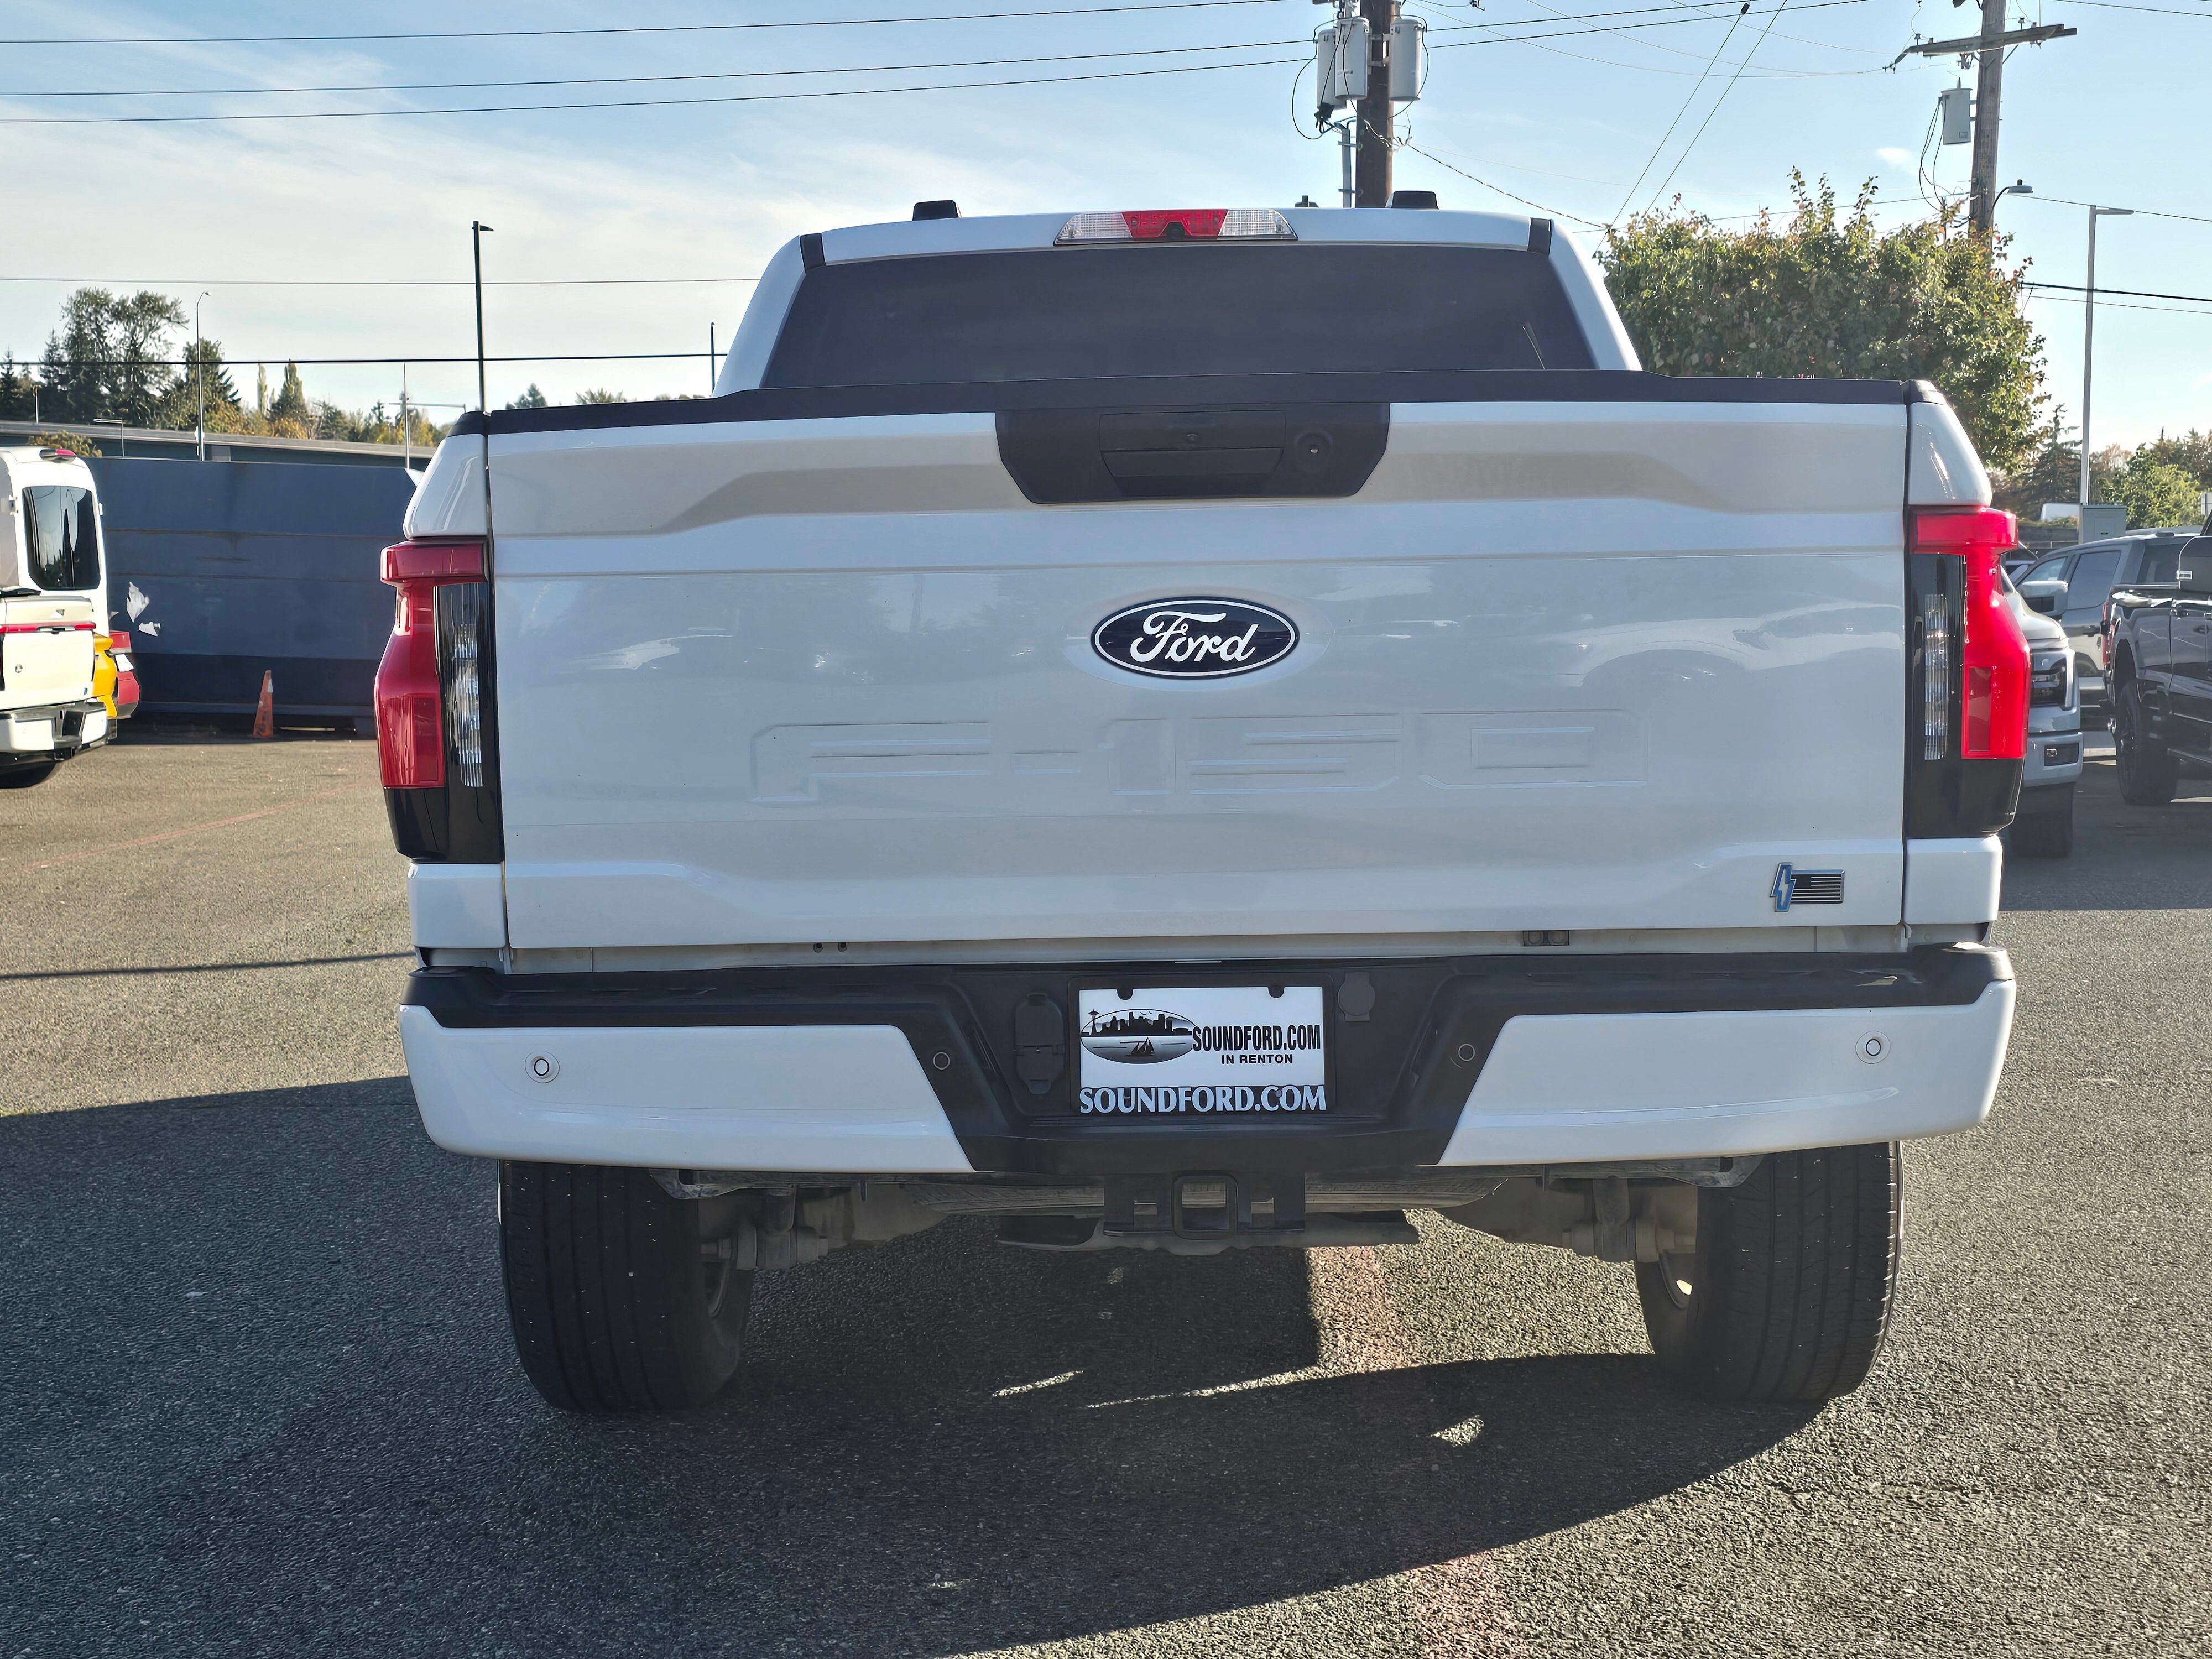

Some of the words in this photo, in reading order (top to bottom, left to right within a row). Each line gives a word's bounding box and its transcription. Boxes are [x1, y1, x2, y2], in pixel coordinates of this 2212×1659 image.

[1130, 611, 1259, 662] Ford
[1192, 1024, 1321, 1052] SOUNDFORD.COM
[1221, 1055, 1234, 1065] IN
[1239, 1053, 1293, 1065] RENTON
[1079, 1085, 1327, 1114] SOUNDFORD.COM
